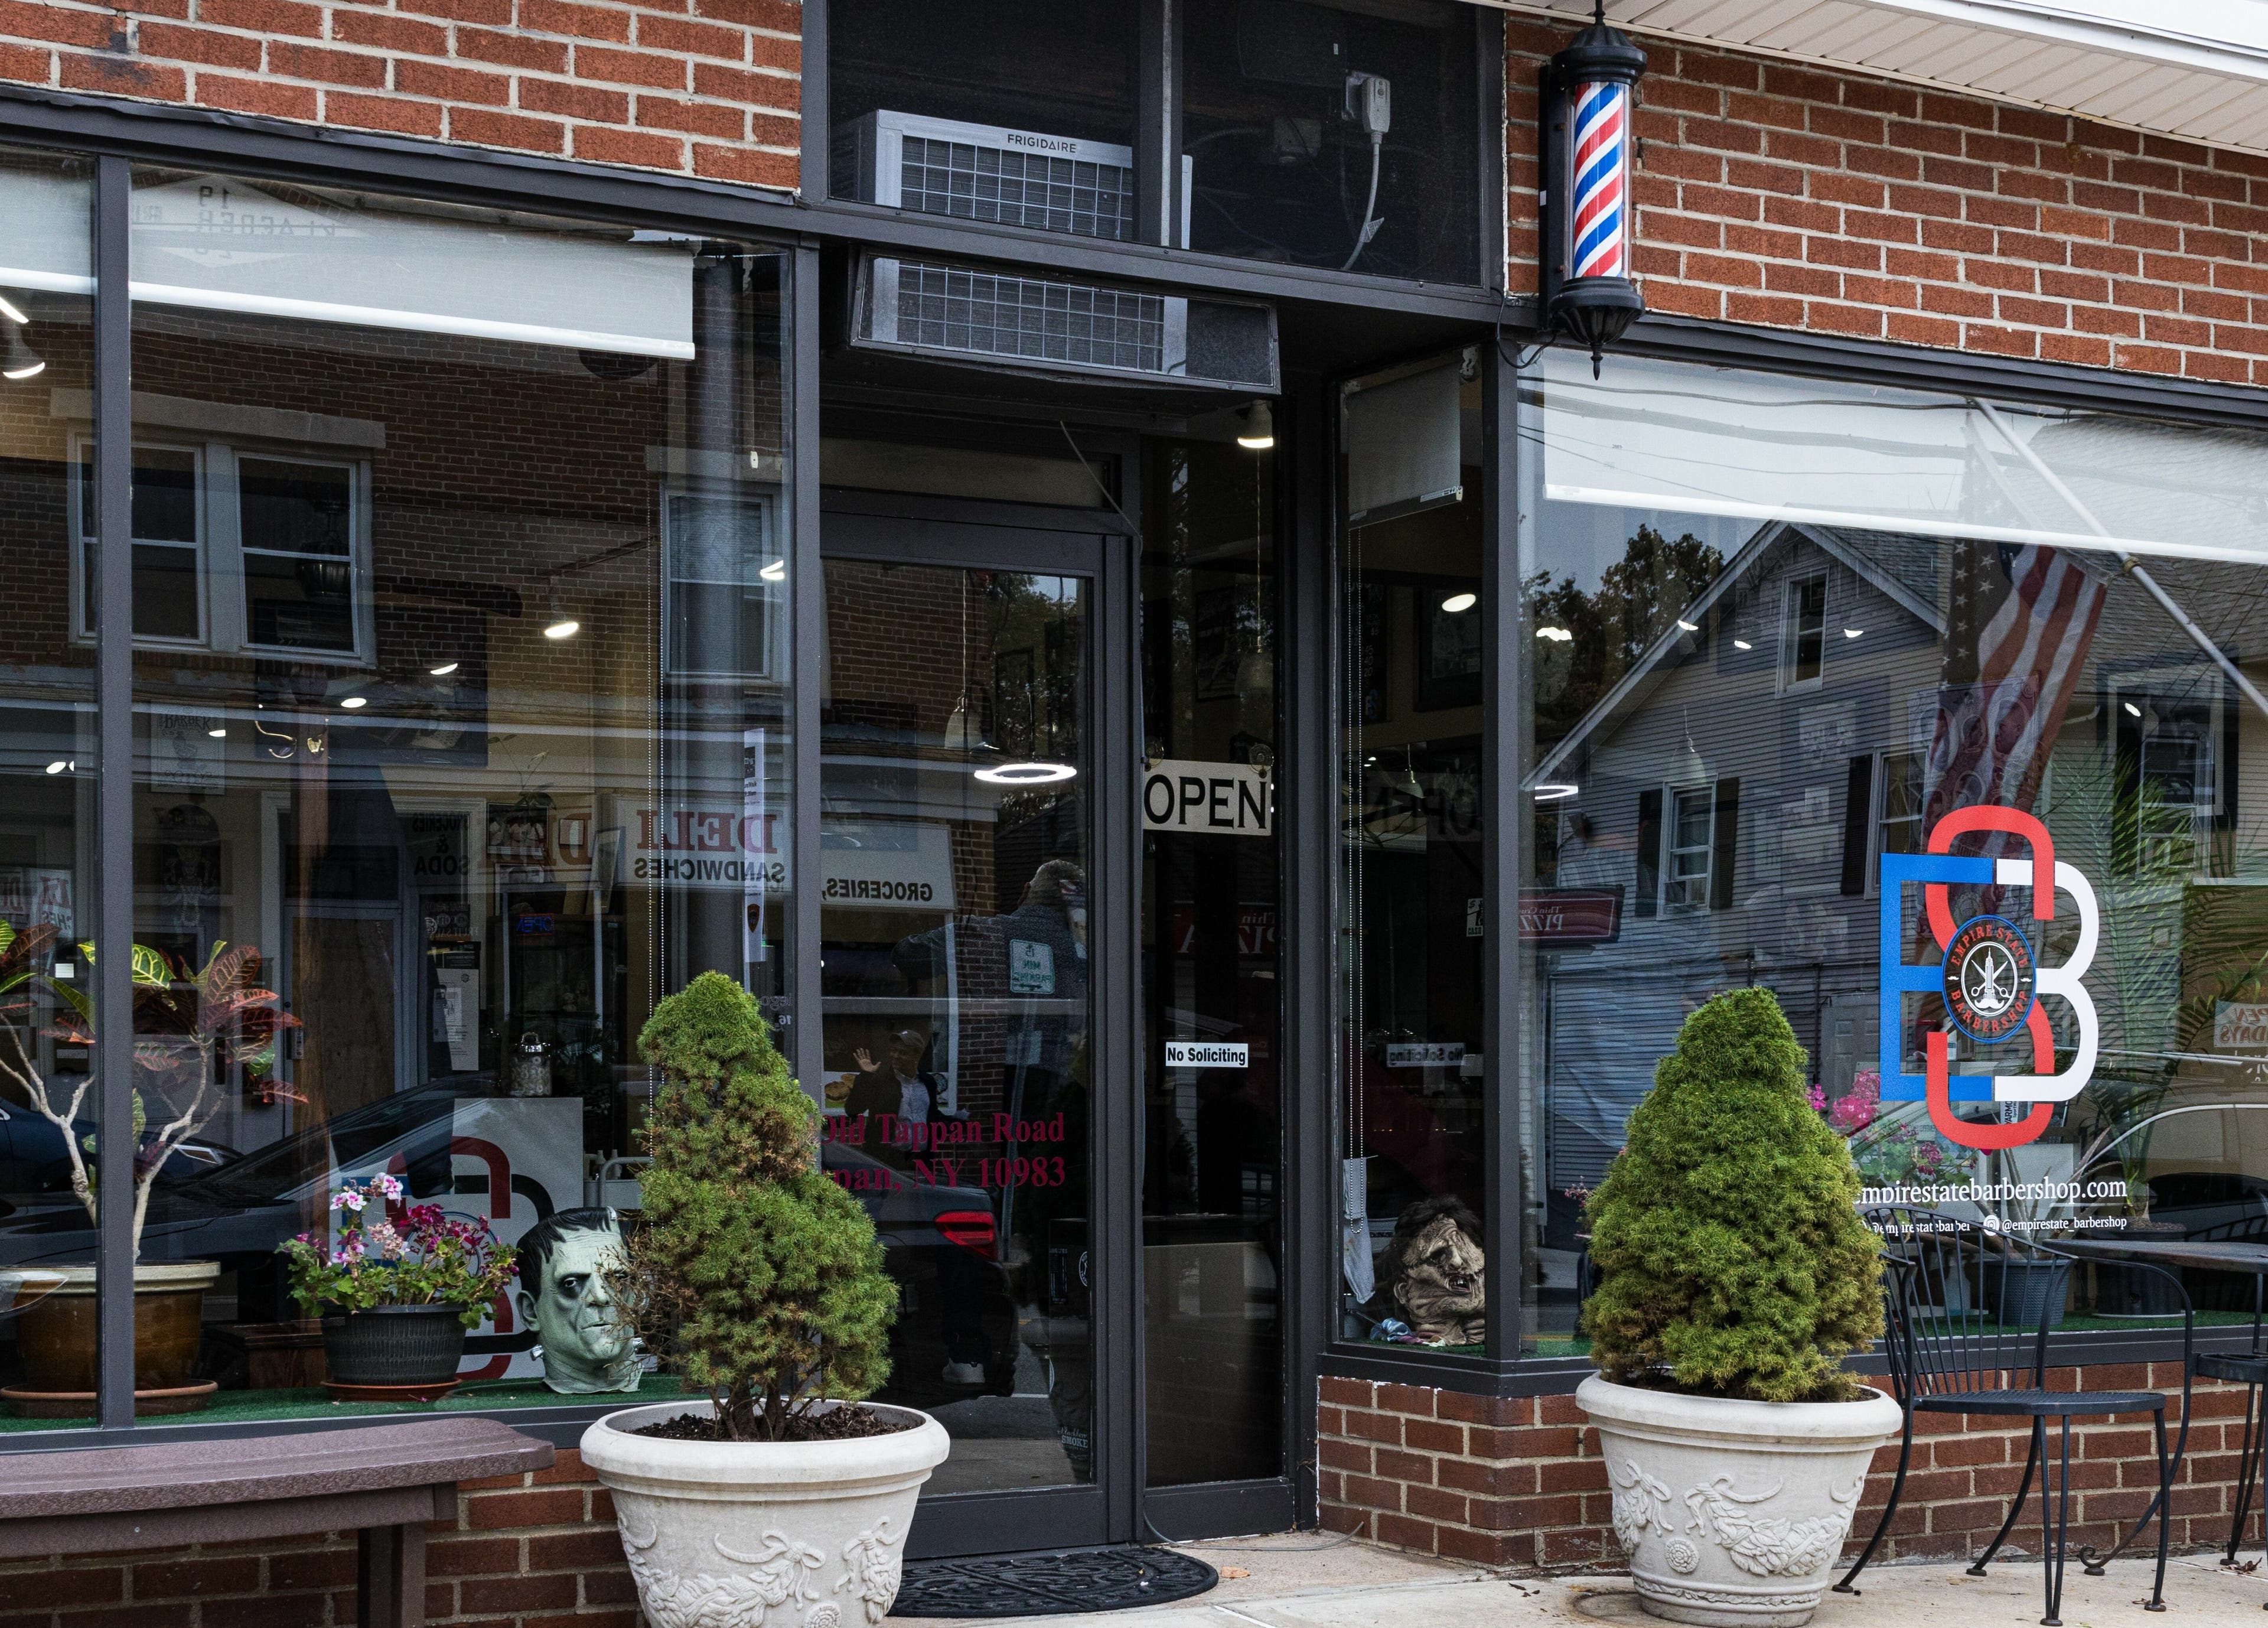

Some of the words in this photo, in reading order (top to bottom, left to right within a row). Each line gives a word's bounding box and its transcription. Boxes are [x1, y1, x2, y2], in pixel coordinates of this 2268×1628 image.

[1007, 134, 1077, 153] FRIGIDAIRE
[1144, 773, 1267, 829] OPEN
[1950, 925, 1992, 967] EMPIRE
[1996, 926, 2029, 969] STATE
[1950, 989, 2029, 1033] BARBERSHOP
[1168, 1047, 1184, 1062] No
[1188, 1047, 1247, 1066] Soliciting
[875, 1113, 982, 1153] Tappan
[993, 1112, 1065, 1143] Road
[913, 1158, 966, 1189] NY
[979, 1157, 1065, 1187] 10983
[2002, 1216, 2127, 1233] @empirestate_barbershop
